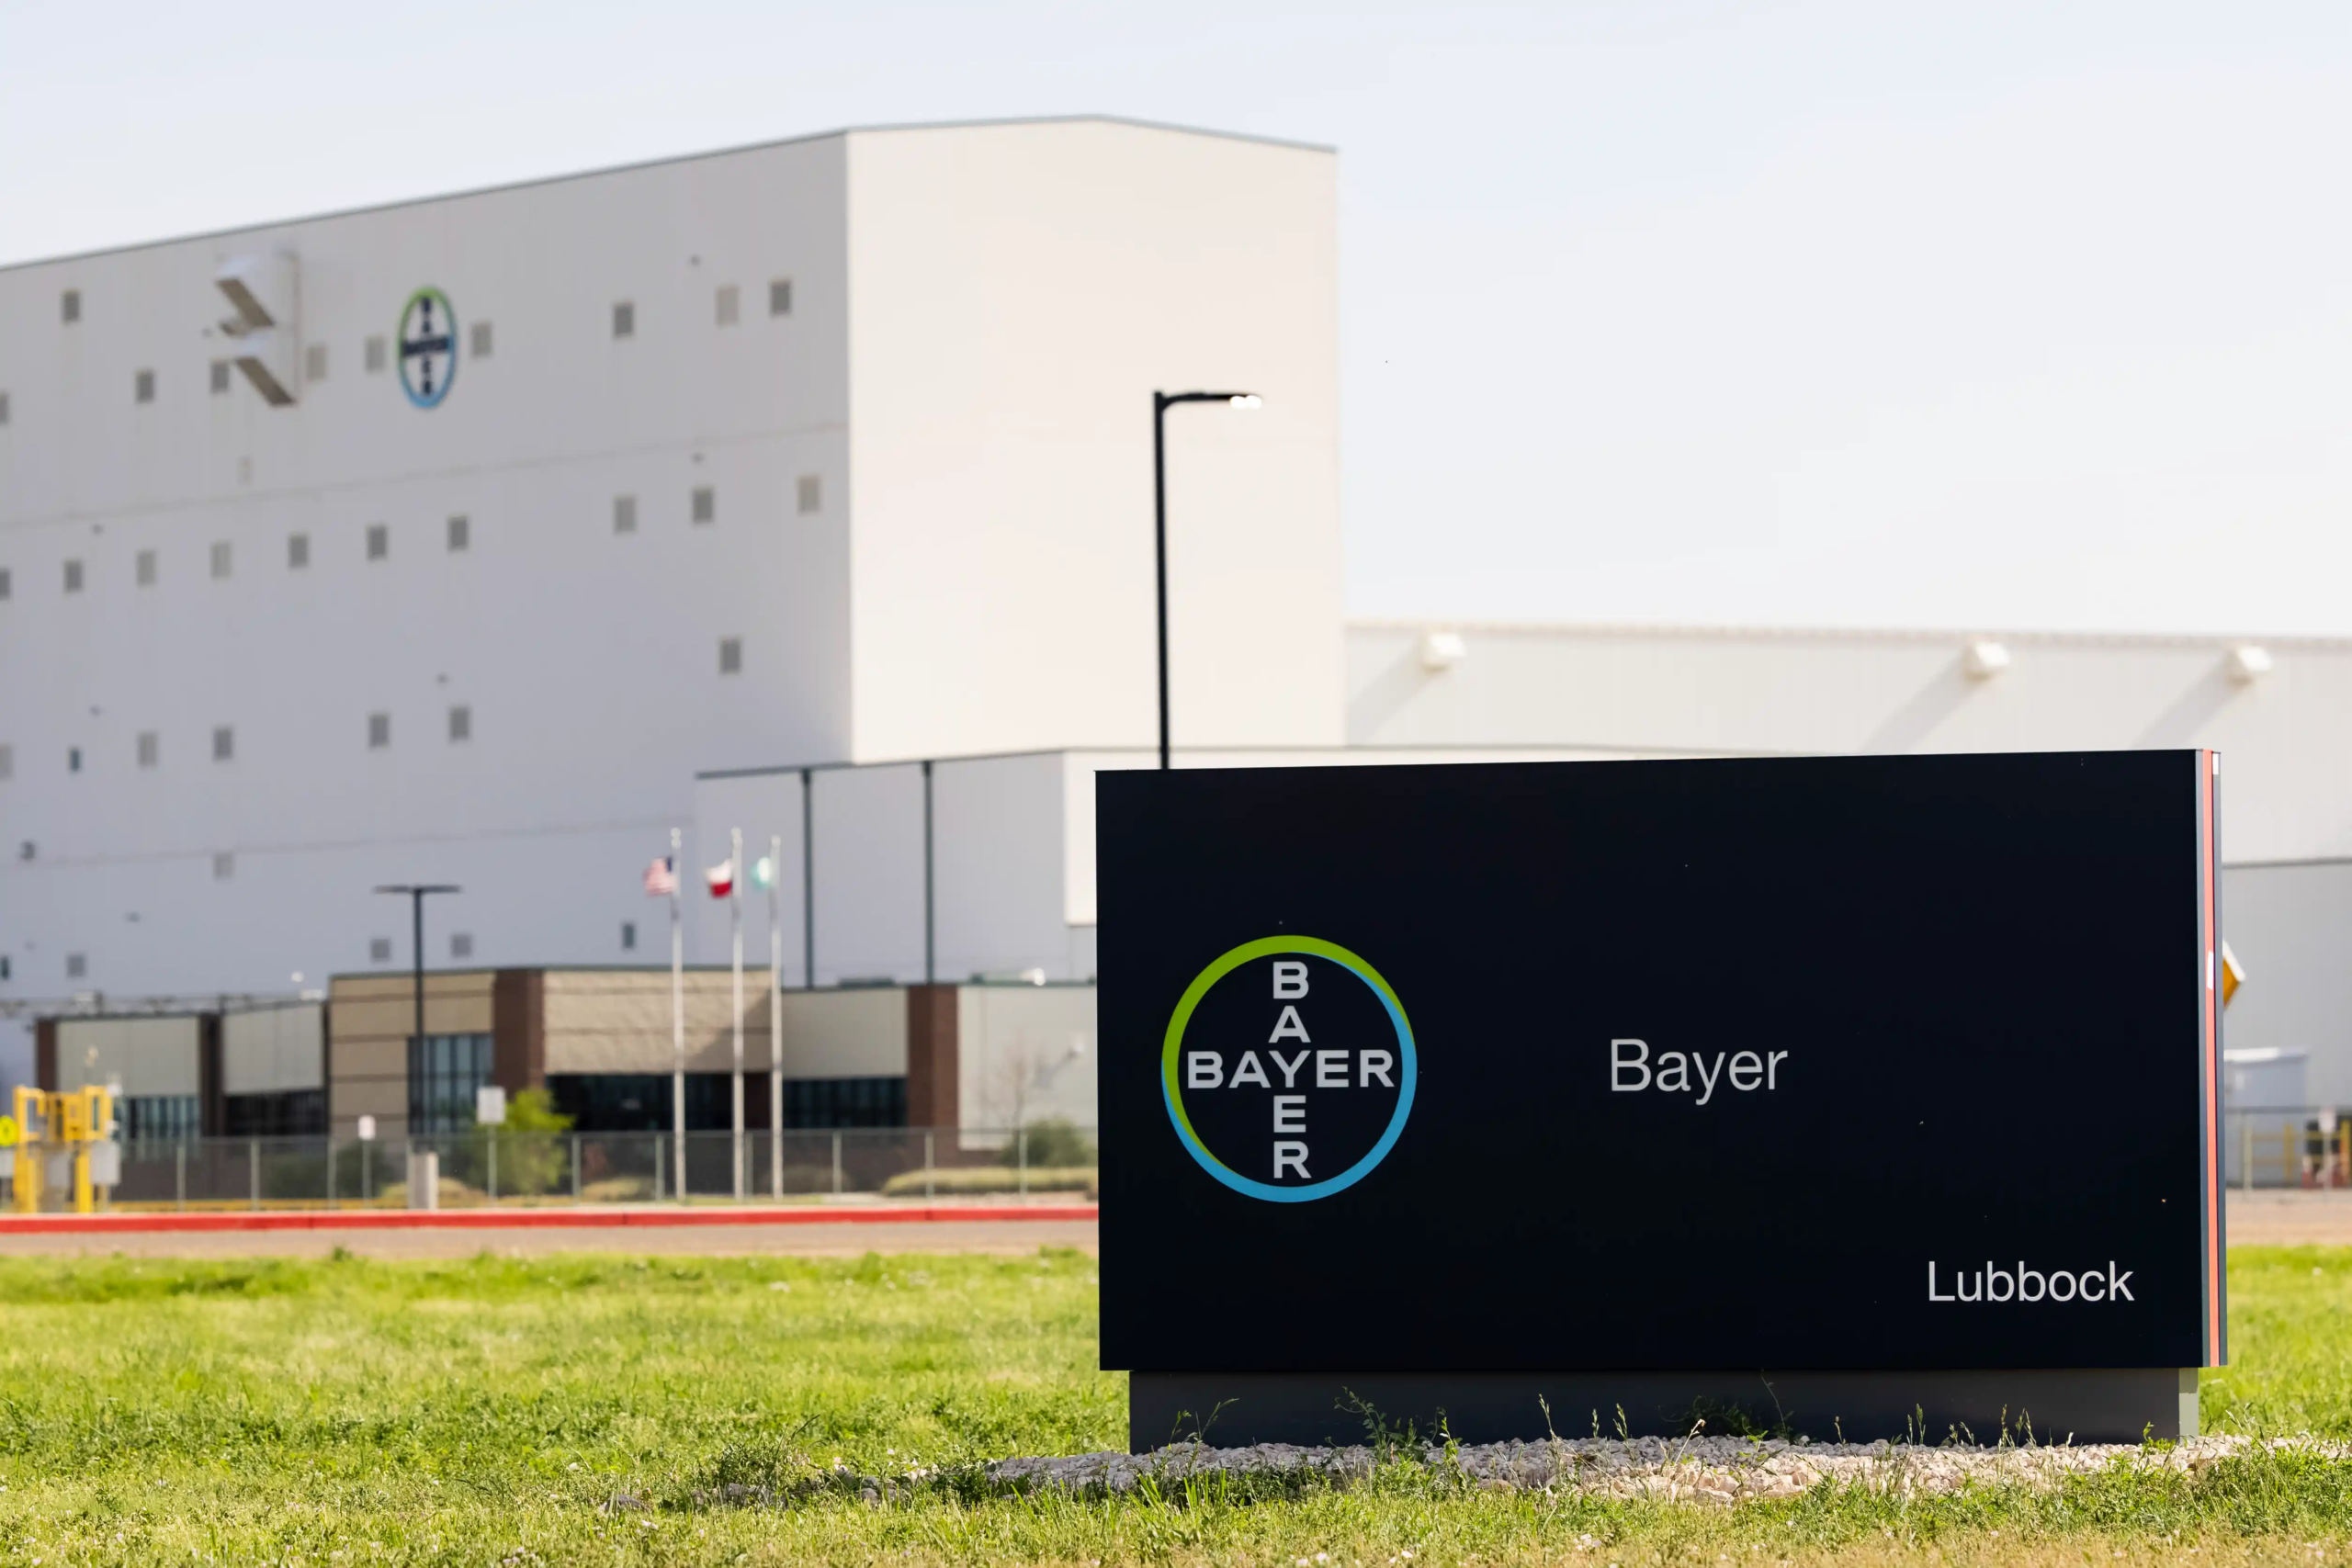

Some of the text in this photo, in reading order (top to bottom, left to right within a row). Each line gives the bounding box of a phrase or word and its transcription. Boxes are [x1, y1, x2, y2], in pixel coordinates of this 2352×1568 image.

[1188, 1050, 1395, 1089] BAYER
[1268, 961, 1312, 1179] BAYER
[1611, 1038, 1788, 1106] Bayer
[1928, 1260, 2135, 1302] Lubbock
